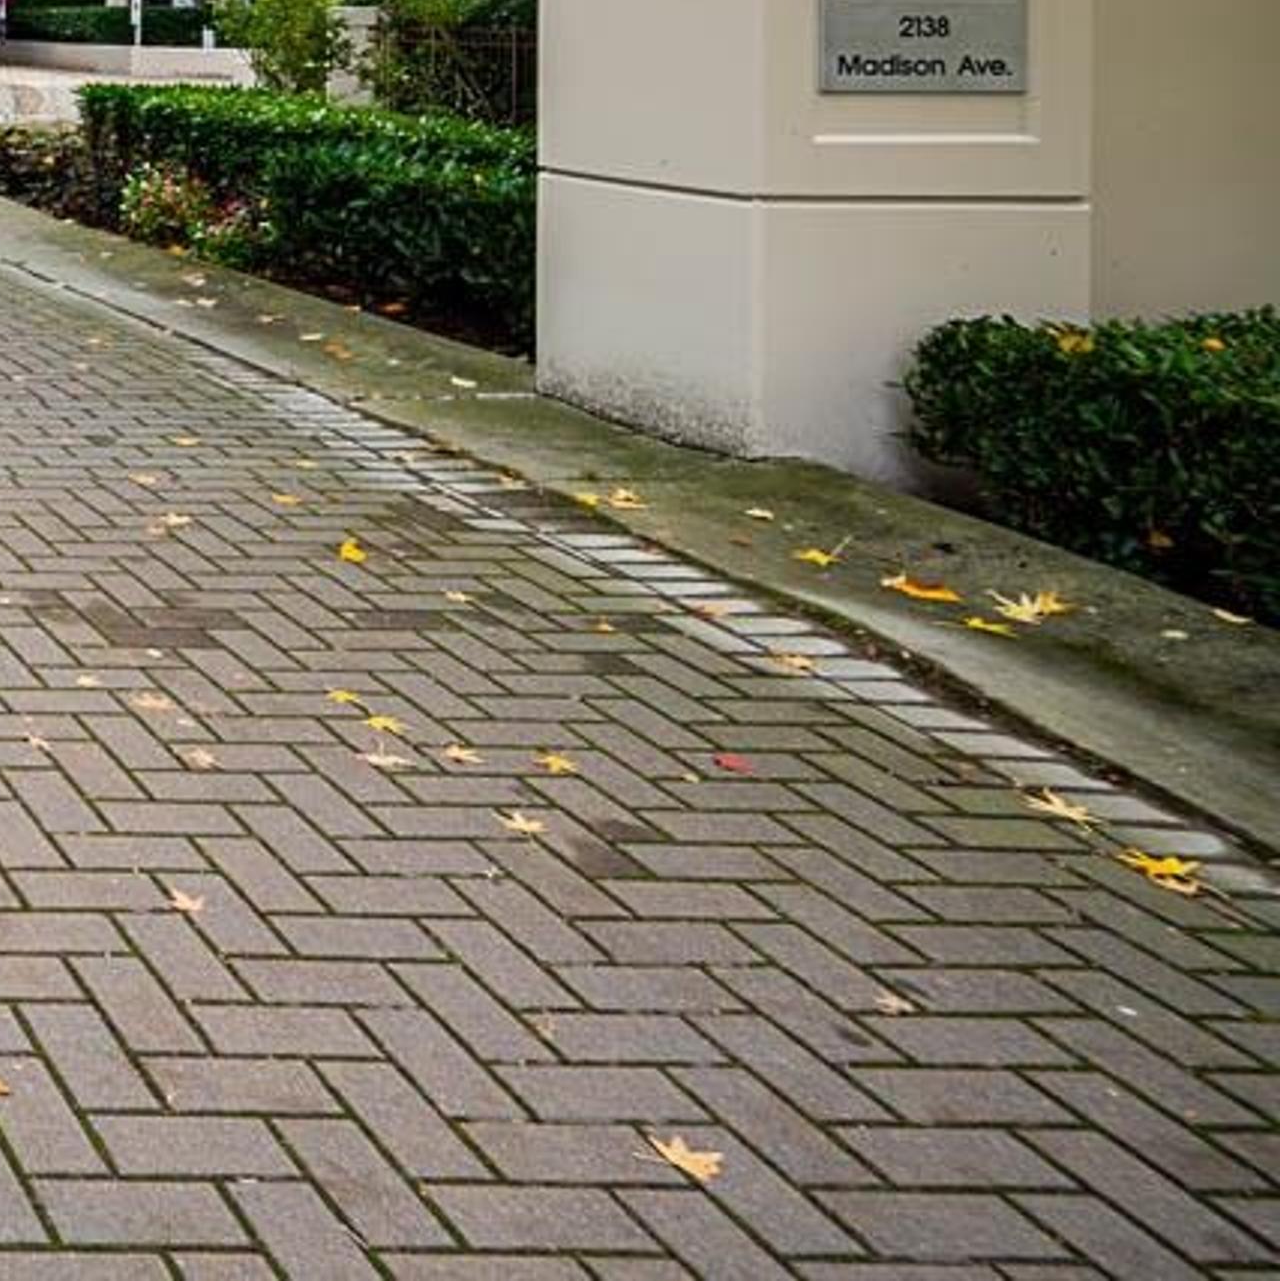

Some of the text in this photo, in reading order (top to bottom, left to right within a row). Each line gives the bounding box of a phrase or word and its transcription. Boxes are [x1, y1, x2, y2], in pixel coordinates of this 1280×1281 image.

[898, 15, 950, 37] 2138
[836, 55, 1013, 76] Madison Ave.
